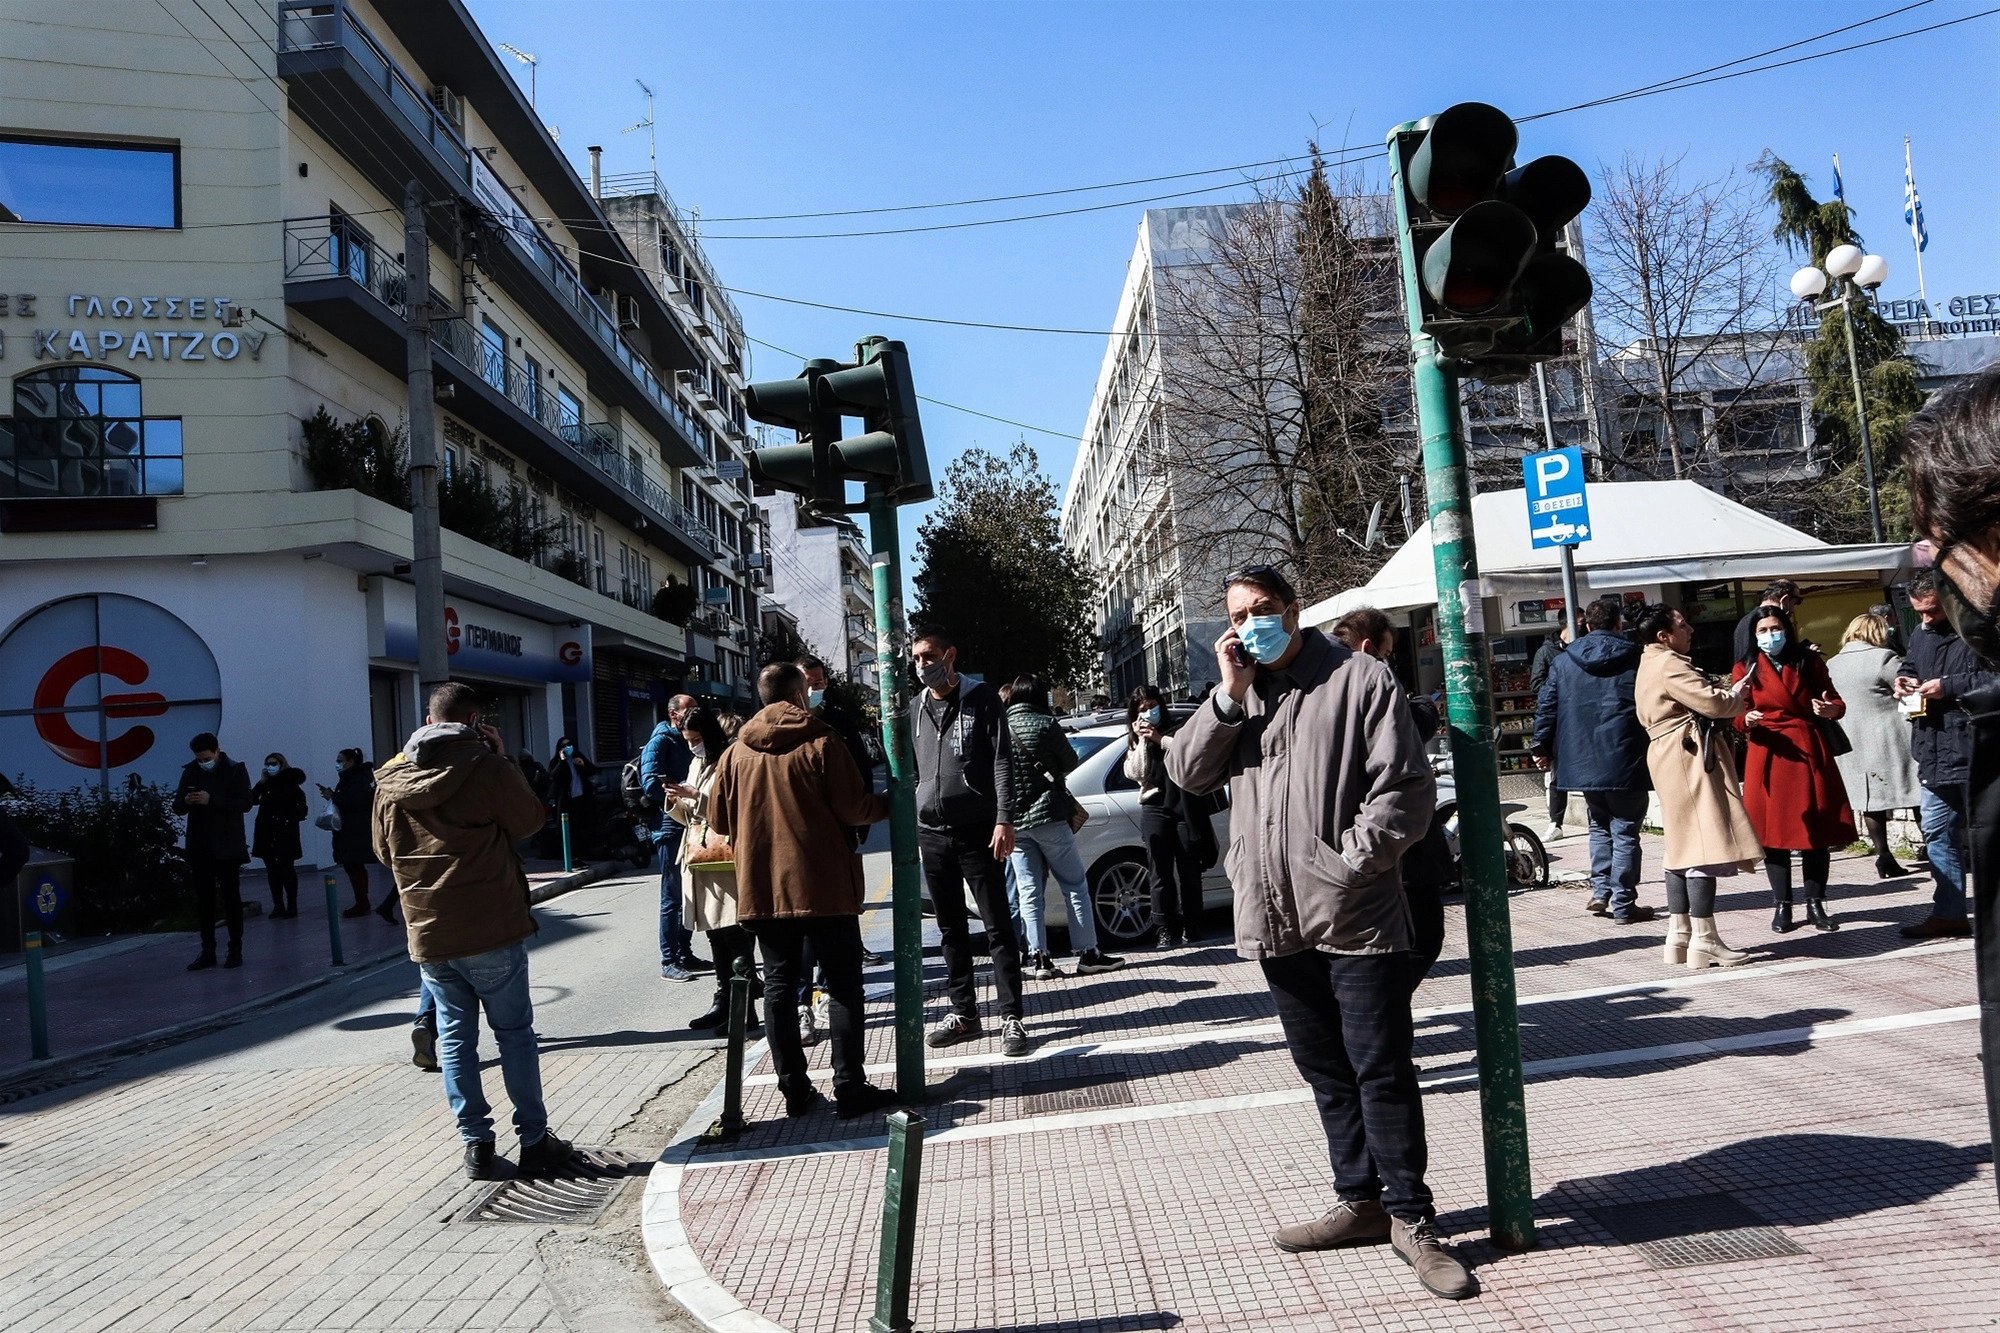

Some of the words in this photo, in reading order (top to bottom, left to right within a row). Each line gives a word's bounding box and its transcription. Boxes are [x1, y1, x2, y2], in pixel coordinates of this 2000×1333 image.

[68, 294, 232, 319] ΓΛΩΣΣΕΣ
[34, 329, 267, 361] ΚΑΡΑΤΖΟΥ
[1535, 453, 1570, 497] P
[1544, 496, 1583, 511] ΘΕΣΕΙΣ
